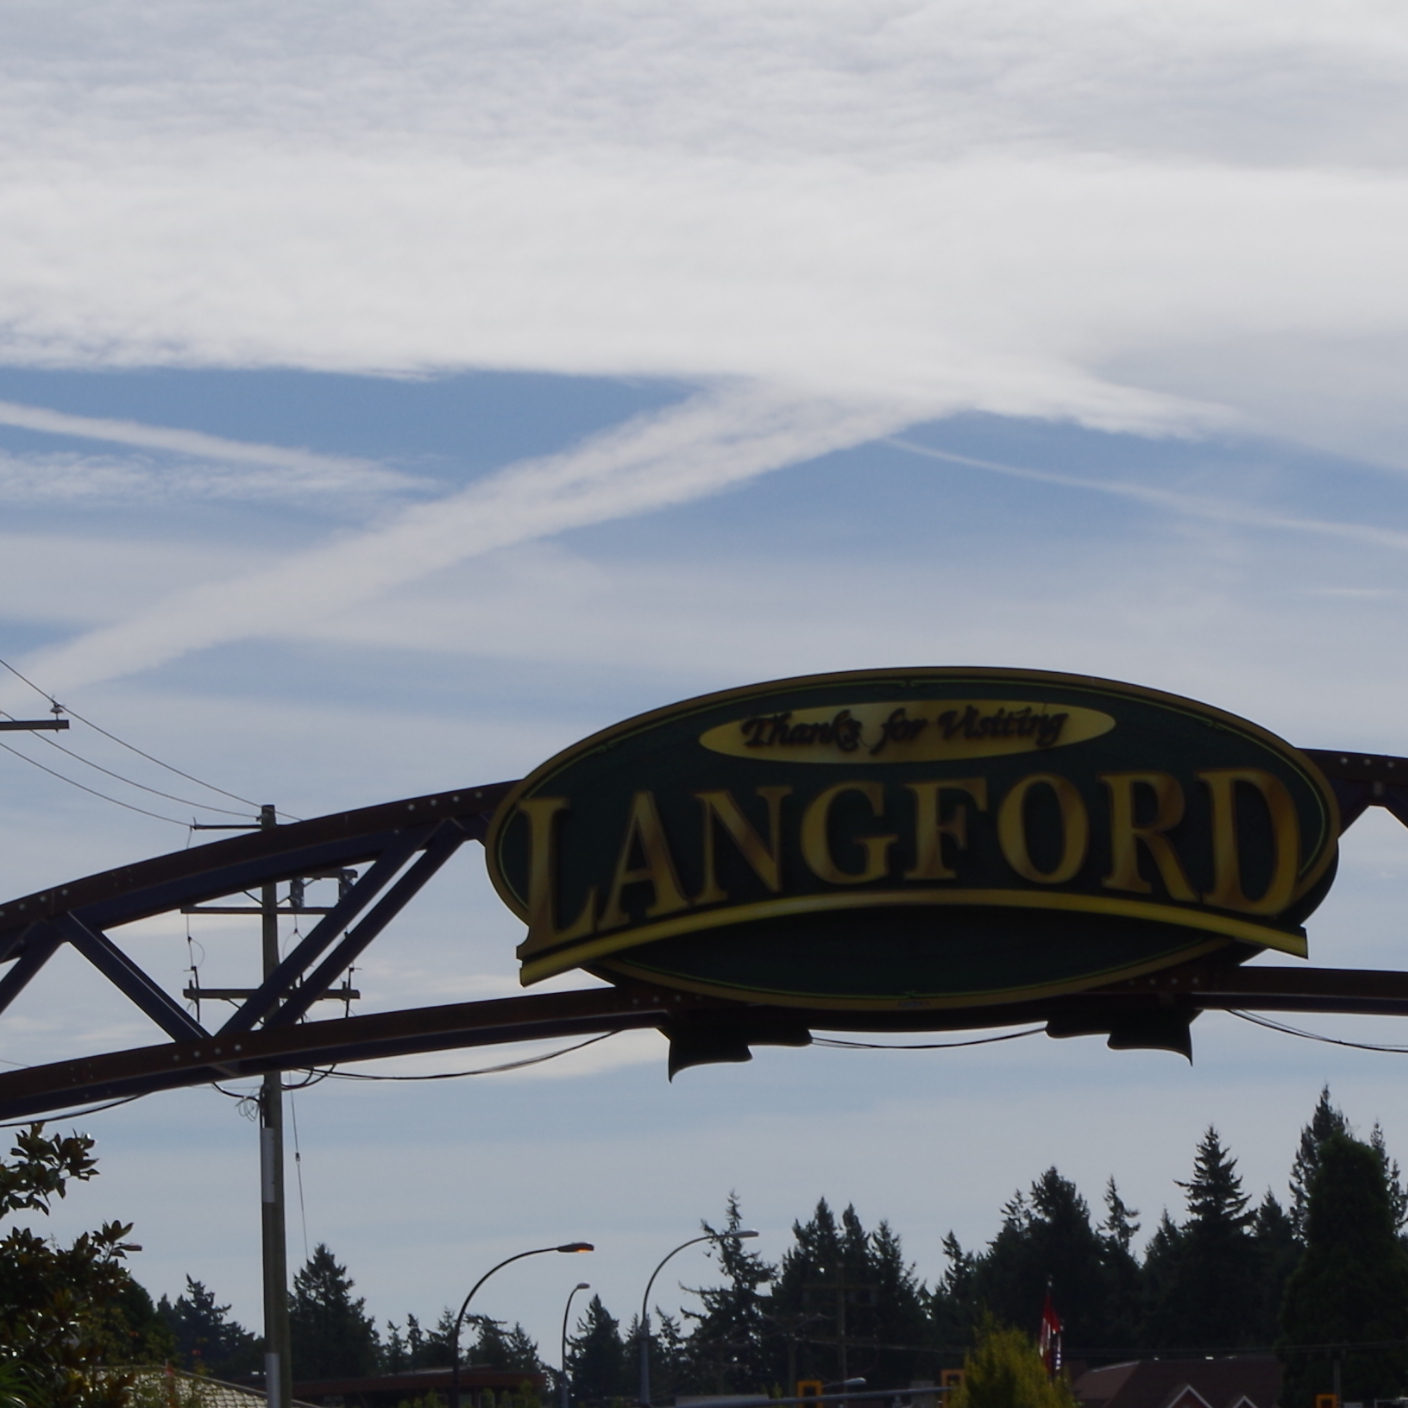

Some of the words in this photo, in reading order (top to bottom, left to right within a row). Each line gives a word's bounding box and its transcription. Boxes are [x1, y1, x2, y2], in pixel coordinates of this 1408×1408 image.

[740, 709, 863, 753] Thanks
[869, 707, 928, 755] for
[936, 704, 1070, 748] Visiting
[516, 767, 1301, 960] LANGFORD
